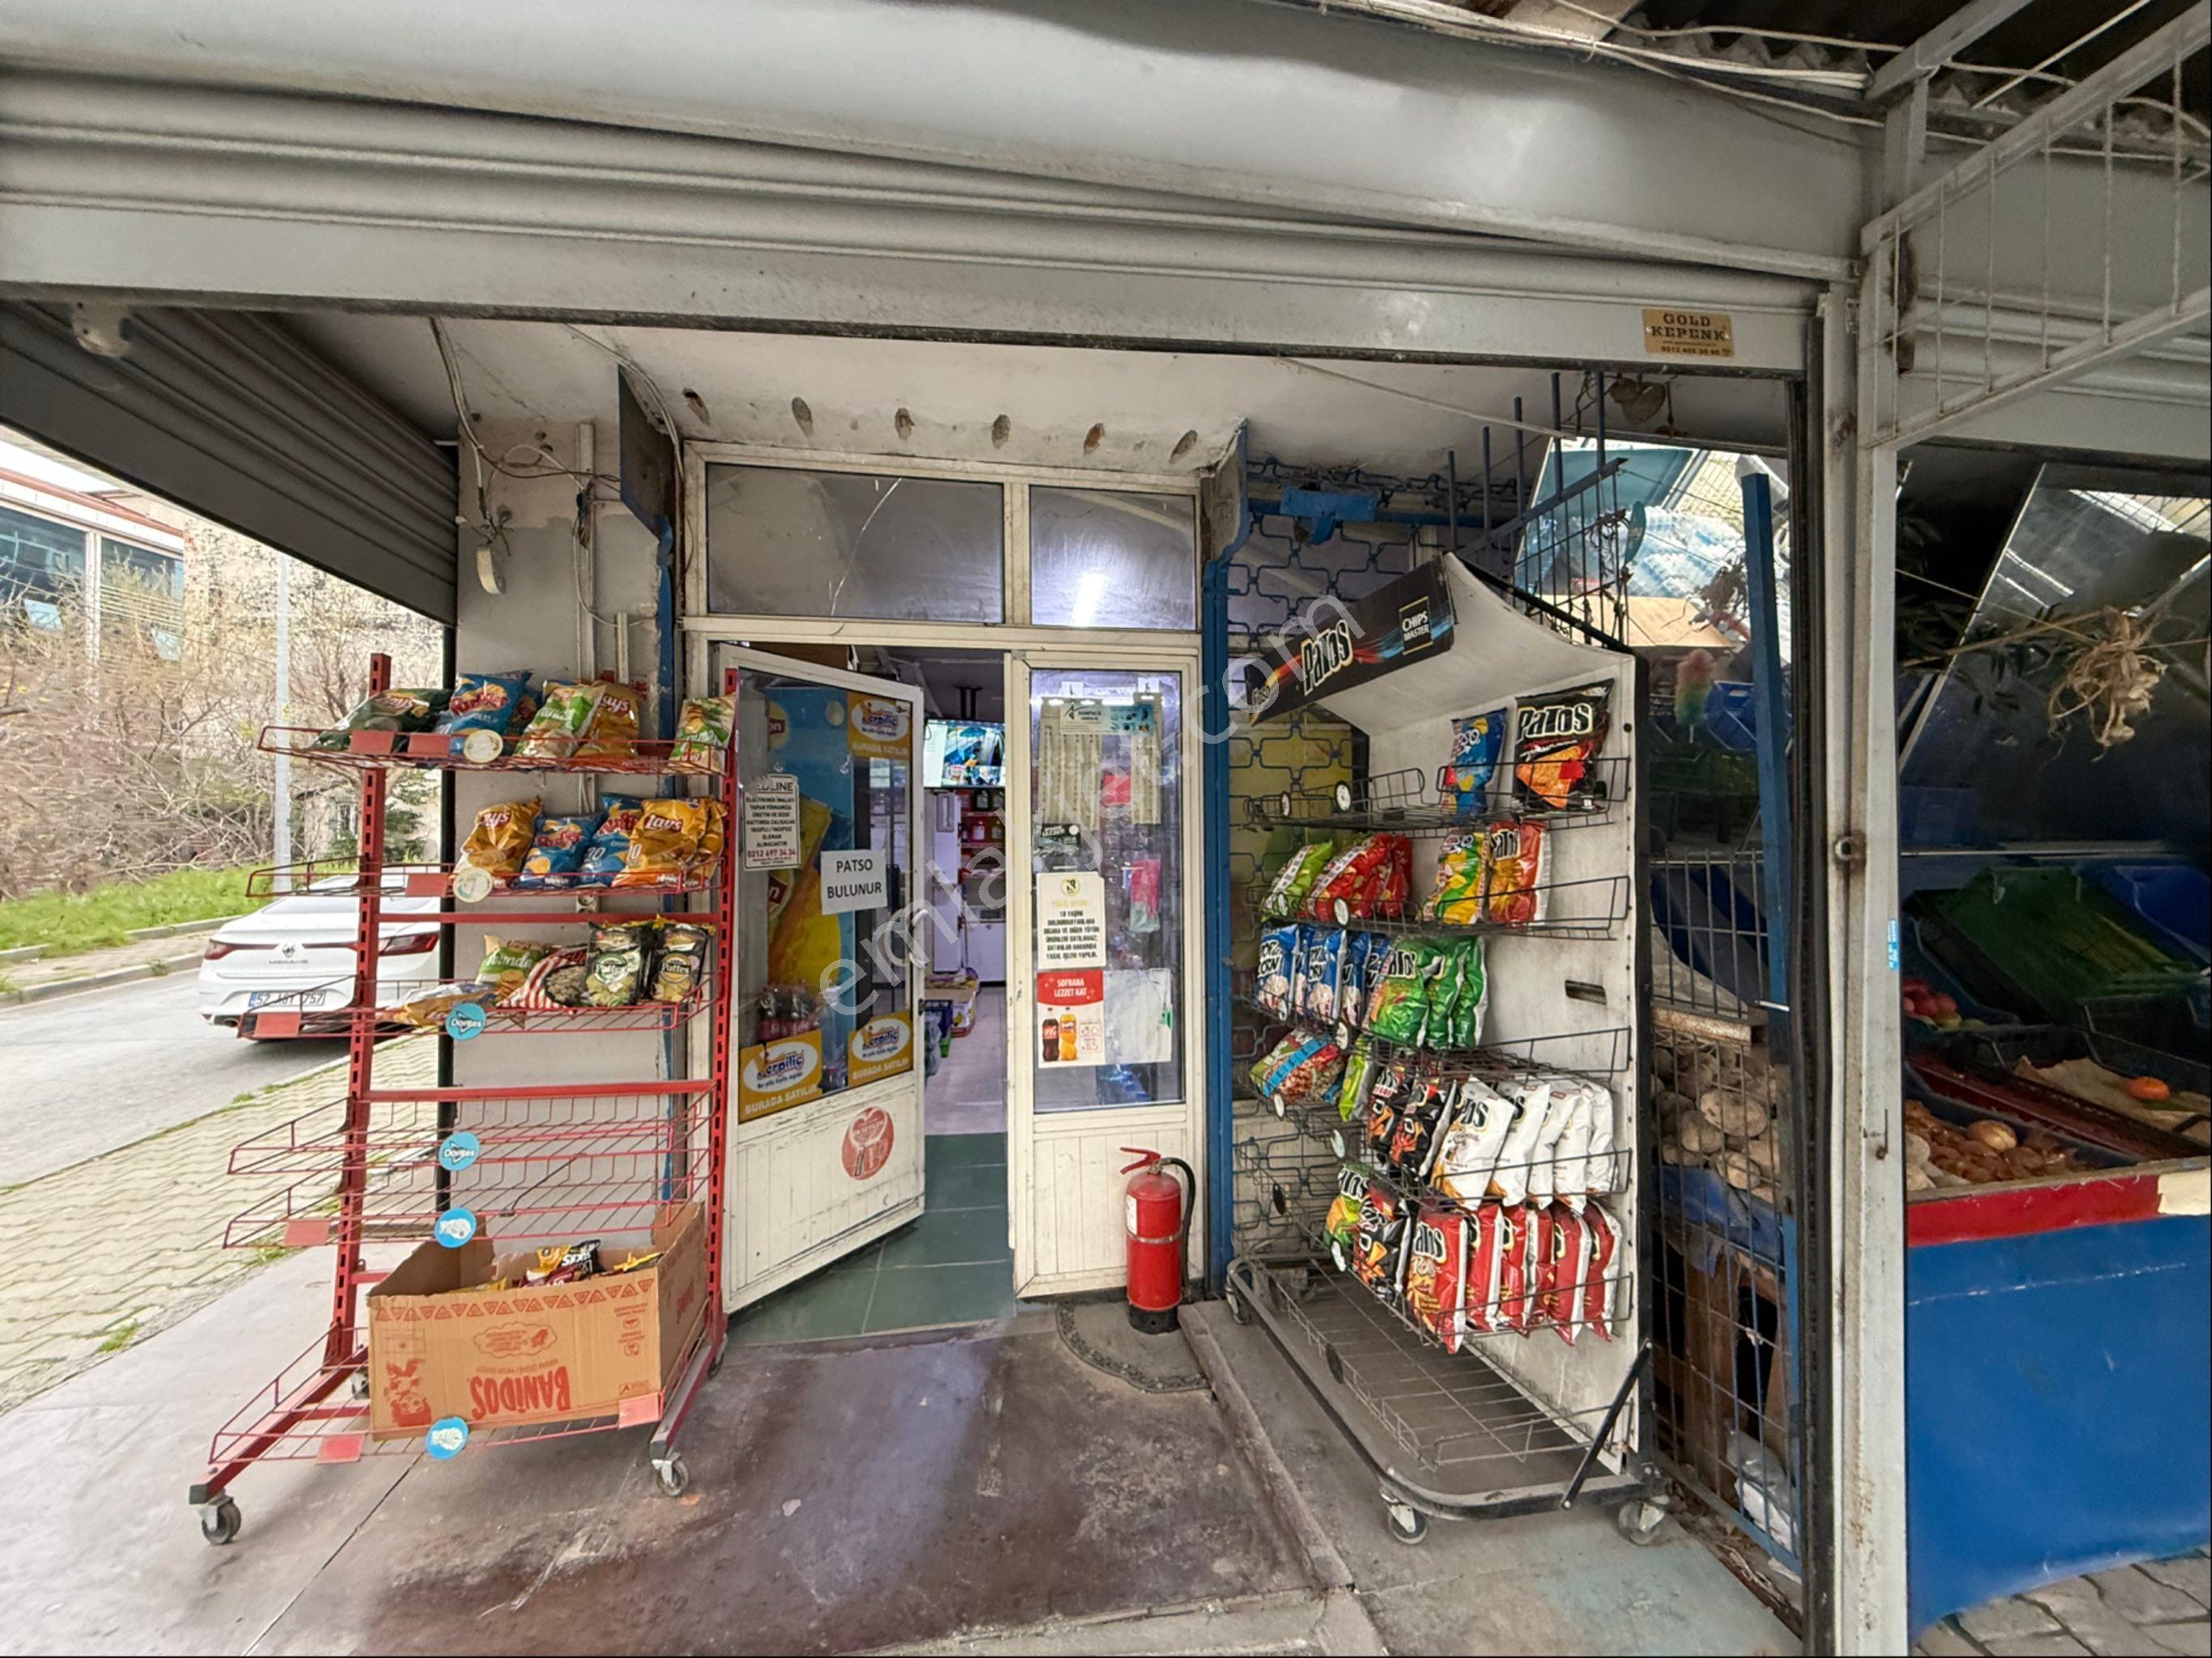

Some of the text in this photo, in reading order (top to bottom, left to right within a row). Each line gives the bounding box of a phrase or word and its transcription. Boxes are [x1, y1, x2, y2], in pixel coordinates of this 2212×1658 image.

[1663, 313, 1710, 326] GOLD
[1652, 326, 1725, 341] KEPENK
[1403, 611, 1428, 631] CHIPS
[1403, 624, 1429, 641] MASTER
[836, 859, 873, 873] PATSO
[827, 881, 882, 899] BULUNUR
[1057, 977, 1085, 987] SOFRANA
[1054, 987, 1087, 997] LEZZET KAT
[745, 1096, 783, 1114] BURADA
